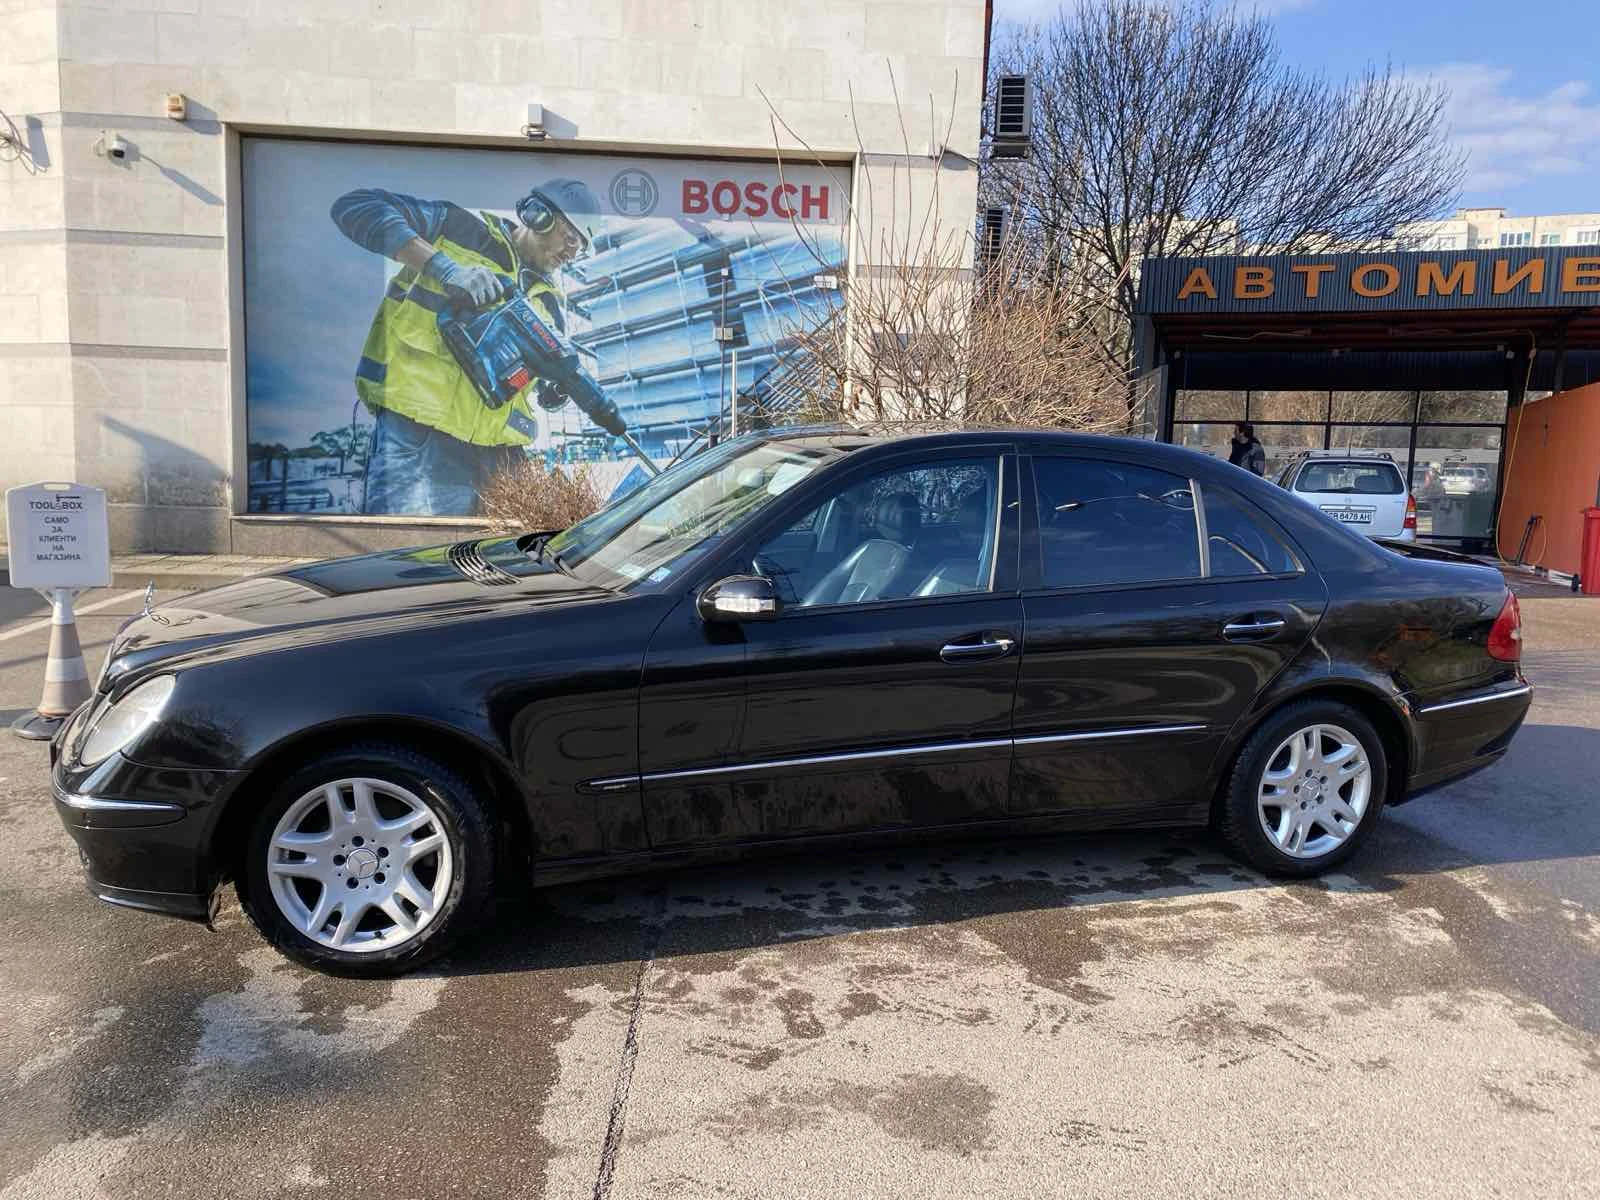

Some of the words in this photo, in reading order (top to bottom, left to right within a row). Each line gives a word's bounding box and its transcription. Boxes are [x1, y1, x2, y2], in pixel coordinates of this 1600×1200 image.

[682, 179, 830, 220] BOSCH
[44, 516, 69, 524] САМО
[38, 535, 77, 543] КЛИЕНТИ
